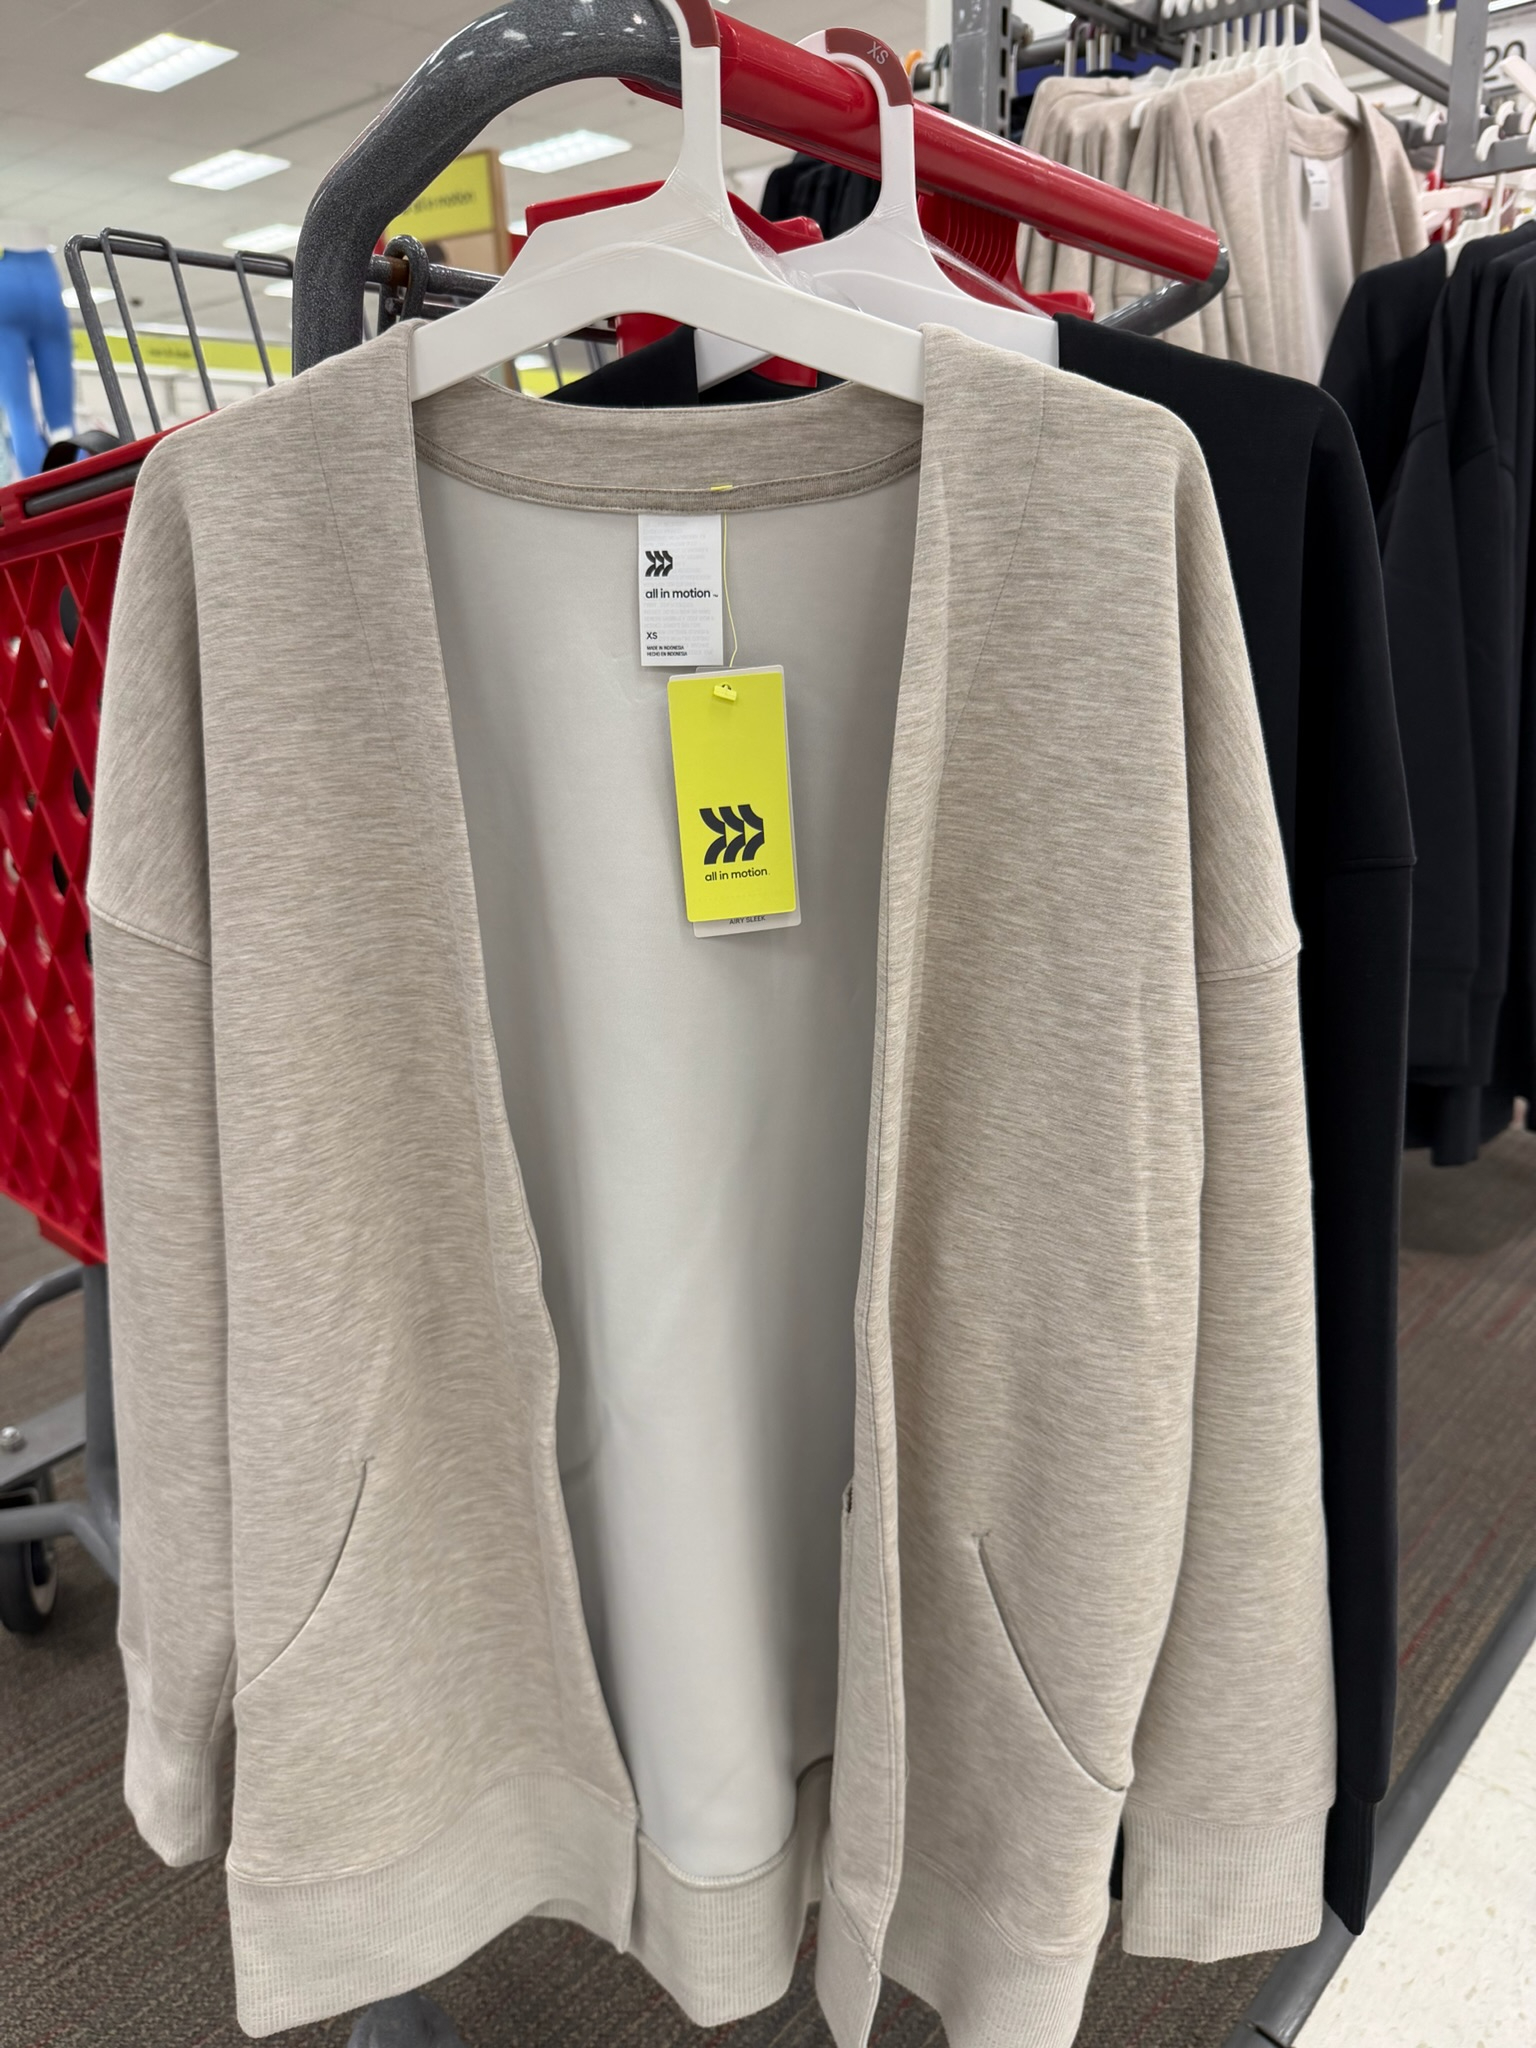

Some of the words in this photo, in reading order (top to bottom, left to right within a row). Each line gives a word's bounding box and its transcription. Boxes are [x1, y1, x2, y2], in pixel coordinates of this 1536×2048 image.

[866, 41, 889, 65] XS
[645, 588, 658, 598] all
[660, 588, 670, 598] in
[672, 587, 711, 598] motion
[646, 632, 658, 640] XS
[705, 871, 717, 881] all
[719, 870, 729, 880] in
[731, 867, 768, 879] motion
[747, 915, 766, 923] SLEEK
